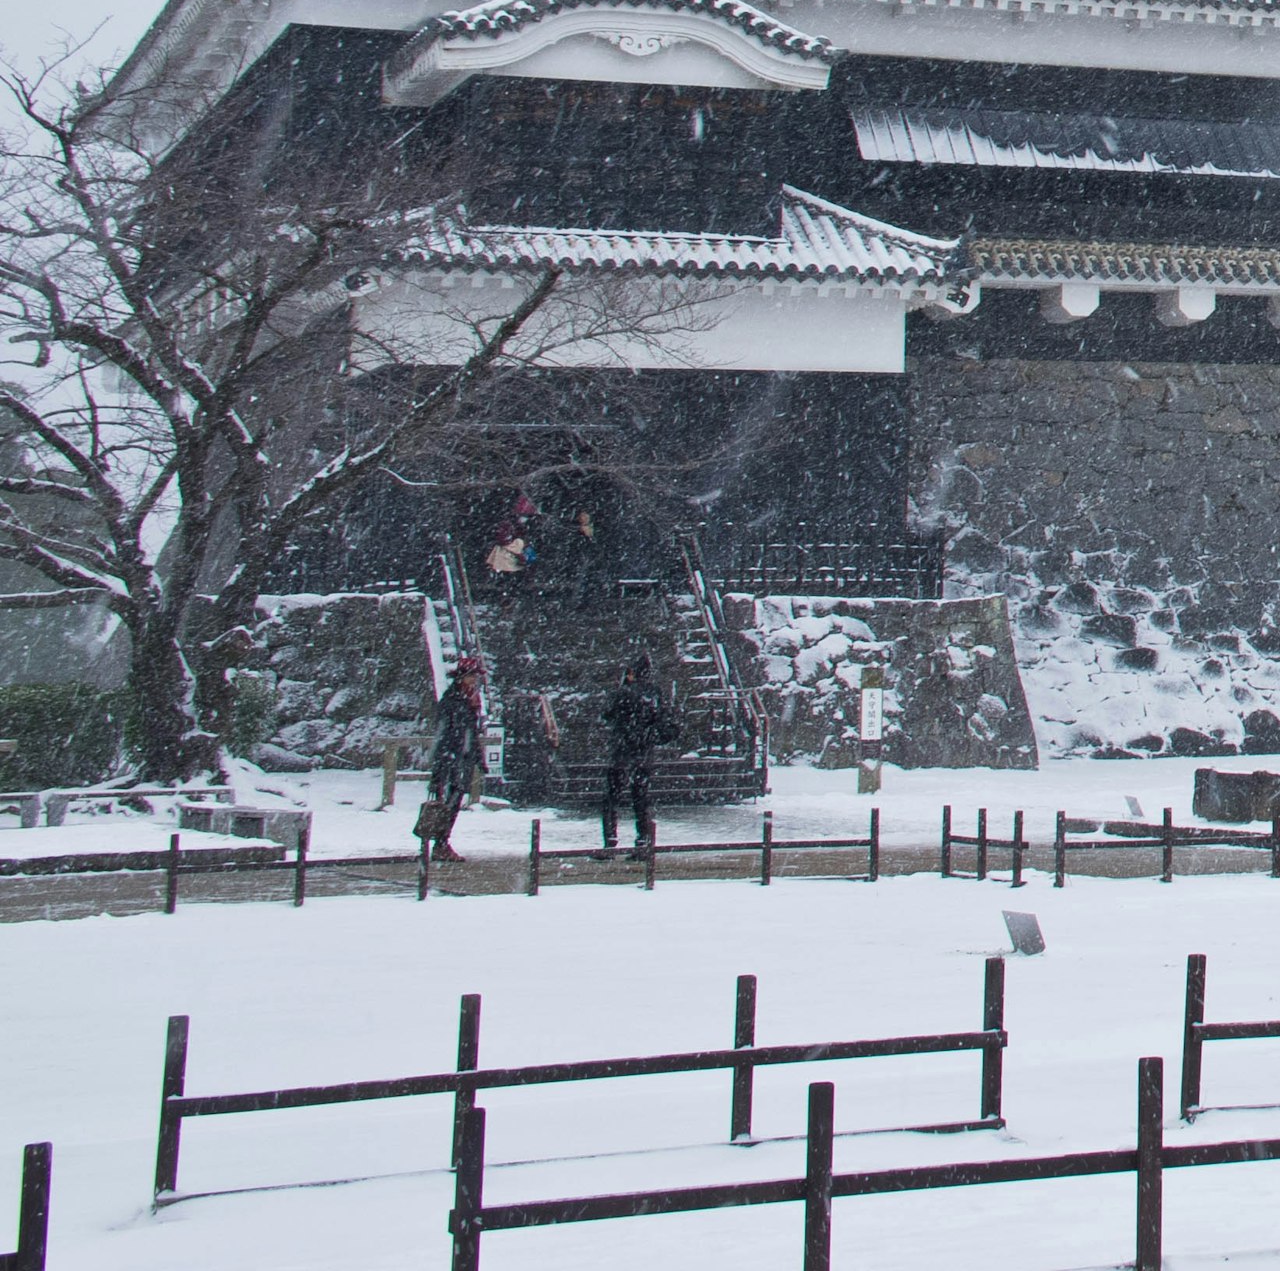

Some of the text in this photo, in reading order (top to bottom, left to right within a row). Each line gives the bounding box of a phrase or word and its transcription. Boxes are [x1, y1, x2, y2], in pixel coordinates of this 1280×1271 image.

[867, 692, 877, 736] 天守閣出口
